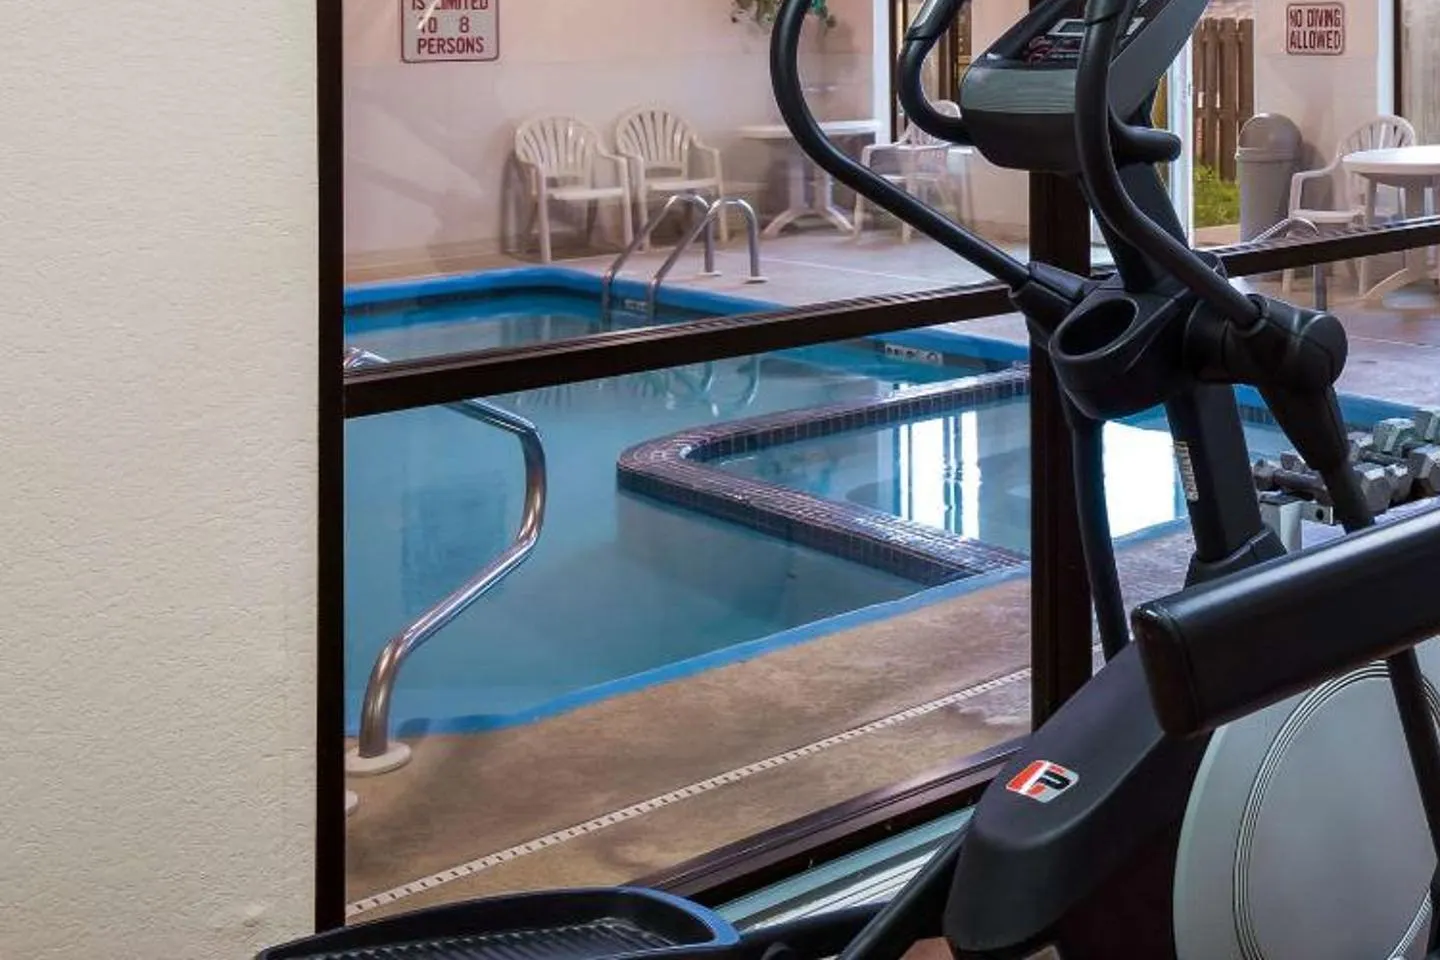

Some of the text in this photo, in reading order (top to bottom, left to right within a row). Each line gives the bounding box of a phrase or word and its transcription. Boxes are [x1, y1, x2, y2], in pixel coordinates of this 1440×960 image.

[459, 16, 470, 34] 8
[1289, 7, 1341, 28] NO DIVING
[416, 36, 485, 55] PERSONS
[1289, 29, 1341, 50] ALLOWED
